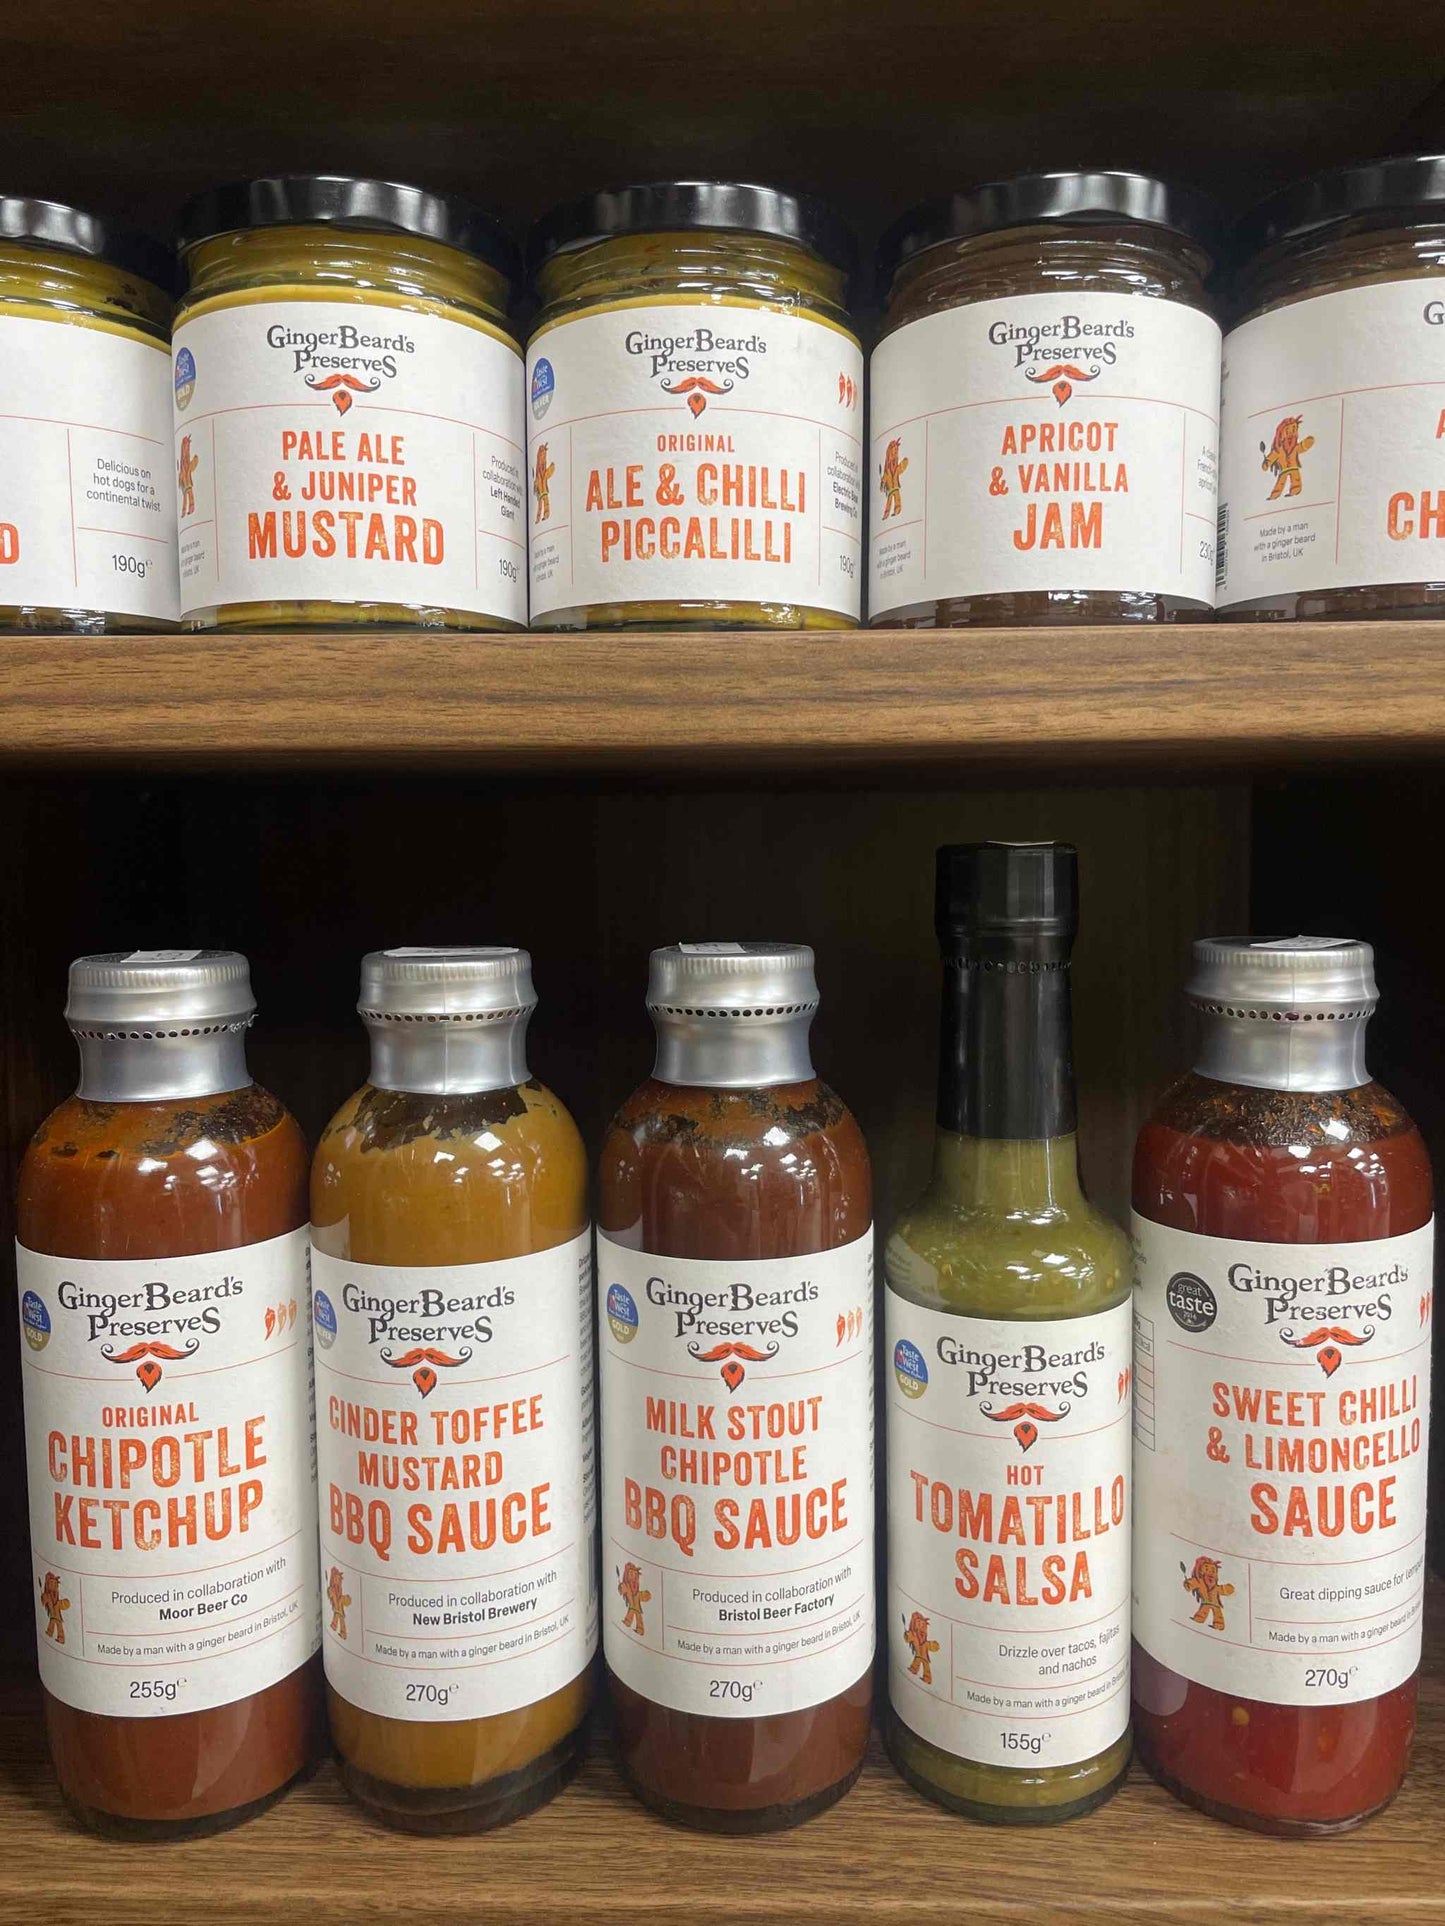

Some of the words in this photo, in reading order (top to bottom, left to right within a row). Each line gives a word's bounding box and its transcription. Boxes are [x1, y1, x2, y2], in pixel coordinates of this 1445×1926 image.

[282, 431, 346, 461] PALE
[357, 433, 405, 465] ALE
[657, 434, 735, 453] ORIGINAL
[1001, 421, 1119, 456] APRICOT
[93, 473, 110, 487] hot
[113, 477, 135, 492] dogs
[137, 481, 149, 493] for
[97, 458, 139, 477] Delicious
[140, 468, 151, 479] on
[586, 464, 644, 512] ALE
[656, 463, 685, 505] &
[696, 462, 805, 513] CHILLI
[988, 466, 1009, 496] &
[1018, 463, 1129, 493] VANILLA
[86, 489, 140, 508] continental
[141, 499, 161, 512] twist
[272, 470, 291, 501] &
[301, 472, 418, 507] JUNIPER
[248, 511, 445, 566] MUSTARD
[601, 516, 791, 564] PICCALILLI
[1013, 502, 1103, 551] JAM
[1168, 1290, 1214, 1317] taste
[1177, 1283, 1202, 1297] great
[102, 1402, 199, 1428] ORIGINAL
[646, 1396, 716, 1440] MILK
[727, 1395, 823, 1441] STOUT
[1212, 1382, 1326, 1427] SWEET
[1338, 1374, 1417, 1426] CHILLI
[329, 1395, 418, 1446] CINDER
[431, 1394, 544, 1446] TOFFEE
[48, 1415, 267, 1490] CHIPOTLE
[1206, 1426, 1230, 1463] &
[1245, 1417, 1420, 1473] LIMONCELLO
[358, 1451, 503, 1491] MUSTARD
[661, 1445, 807, 1487] CHIPOTLE
[1007, 1465, 1044, 1486] HOT
[54, 1479, 264, 1551] KETCHUP
[330, 1482, 391, 1561] BBQ
[407, 1482, 552, 1555] SAUCE
[624, 1477, 696, 1557] BBQ
[713, 1477, 848, 1550] SAUCE
[910, 1470, 1125, 1546] TOMATILLO
[1250, 1475, 1397, 1538] SAUCE
[111, 1591, 170, 1604] Produced
[173, 1590, 184, 1601] in
[187, 1571, 263, 1599] collaboration
[265, 1557, 286, 1575] with
[388, 1592, 444, 1608] Produced
[447, 1596, 457, 1607] in
[460, 1582, 535, 1606] collaboration
[536, 1570, 557, 1589] with
[692, 1588, 748, 1604] Produced
[752, 1591, 762, 1602] in
[765, 1577, 833, 1602] collaboration
[835, 1565, 852, 1584] with
[955, 1548, 1092, 1606] SALSA
[1279, 1587, 1315, 1601] Great
[1318, 1586, 1362, 1602] dipping
[1364, 1579, 1392, 1596] sauce
[1393, 1573, 1404, 1586] for
[159, 1607, 194, 1621] Moor
[197, 1600, 227, 1616] Beer
[231, 1593, 248, 1606] Co
[413, 1613, 440, 1626] New
[443, 1611, 485, 1625] Bristol
[489, 1597, 537, 1620] Brewery
[719, 1608, 760, 1622] Bristol
[763, 1606, 792, 1620] Beer
[794, 1594, 835, 1616] Factory
[97, 1644, 122, 1655] Made
[123, 1645, 134, 1657] by
[136, 1647, 142, 1655] a
[143, 1646, 164, 1655] man
[166, 1643, 187, 1653] with
[188, 1643, 195, 1652] a
[196, 1635, 225, 1652] ginger
[227, 1624, 253, 1642] beard
[254, 1621, 262, 1633] in
[289, 1601, 299, 1613] UK
[375, 1644, 398, 1657] Made
[399, 1648, 410, 1660] by
[411, 1650, 417, 1658] a
[418, 1650, 437, 1659] man
[439, 1648, 459, 1658] with
[461, 1649, 467, 1657] a
[469, 1644, 497, 1659] ginger
[499, 1634, 524, 1651] beard
[525, 1631, 532, 1642] in
[559, 1615, 569, 1626] UK
[677, 1639, 701, 1652] Made
[703, 1644, 714, 1655] by
[723, 1646, 742, 1655] man
[743, 1644, 764, 1655] with
[772, 1639, 799, 1656] ginger
[801, 1632, 823, 1648] beard
[824, 1628, 831, 1639] in
[999, 1645, 1038, 1658] Drizzle
[1041, 1647, 1065, 1658] over
[1068, 1638, 1097, 1655] tacos,
[1268, 1631, 1296, 1643] Made
[1298, 1633, 1309, 1644] by
[1319, 1634, 1339, 1643] man
[1341, 1630, 1359, 1642] with
[1366, 1624, 1390, 1639] ginger
[1039, 1664, 1059, 1676] and
[1062, 1655, 1097, 1672] nachos
[967, 1691, 991, 1704] Made
[993, 1695, 1004, 1707] by
[1013, 1698, 1032, 1708] man
[1034, 1696, 1053, 1708] with
[1062, 1692, 1086, 1708] ginger
[1087, 1682, 1106, 1699] beard
